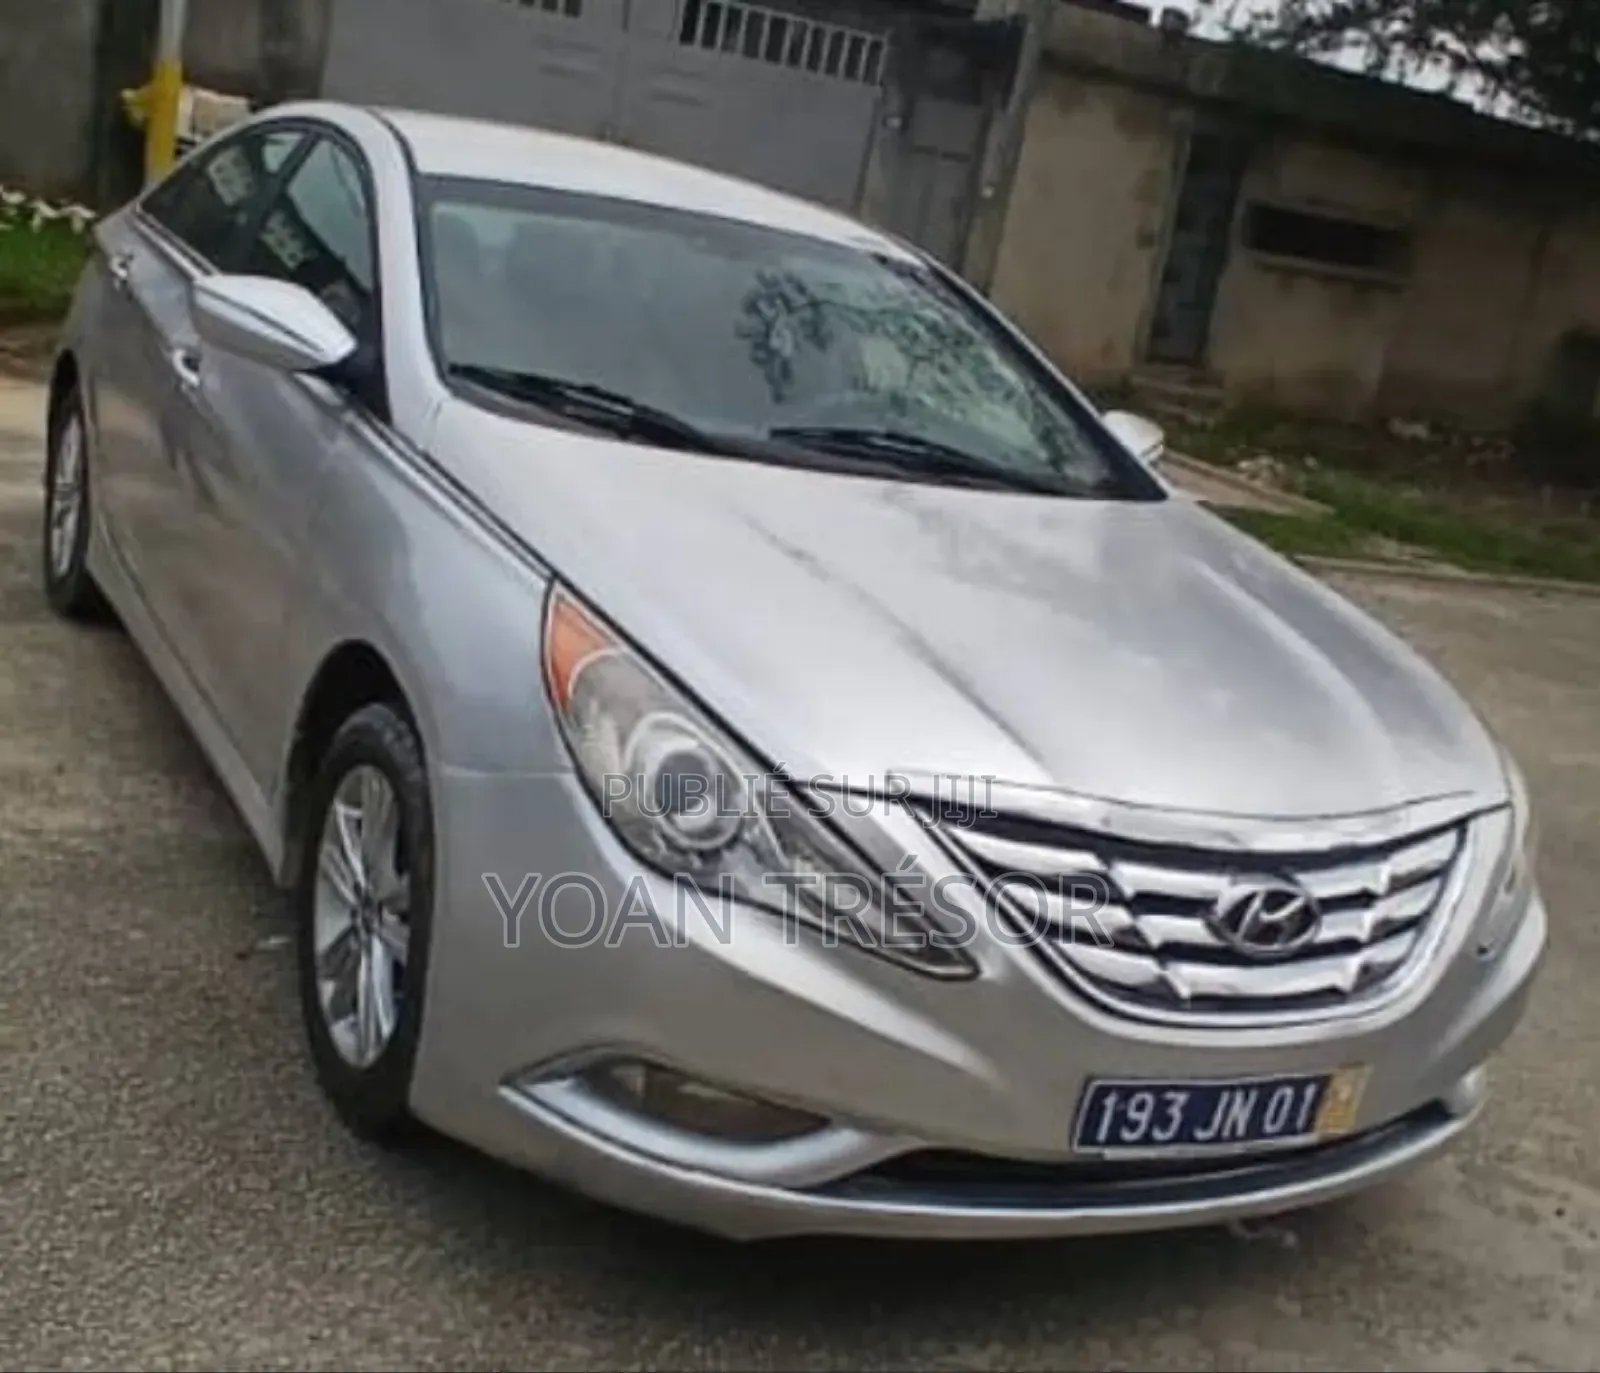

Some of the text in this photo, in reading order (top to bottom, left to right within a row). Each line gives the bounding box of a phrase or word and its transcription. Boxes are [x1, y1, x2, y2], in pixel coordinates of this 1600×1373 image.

[1095, 1083, 1319, 1143] 193 JN 01
